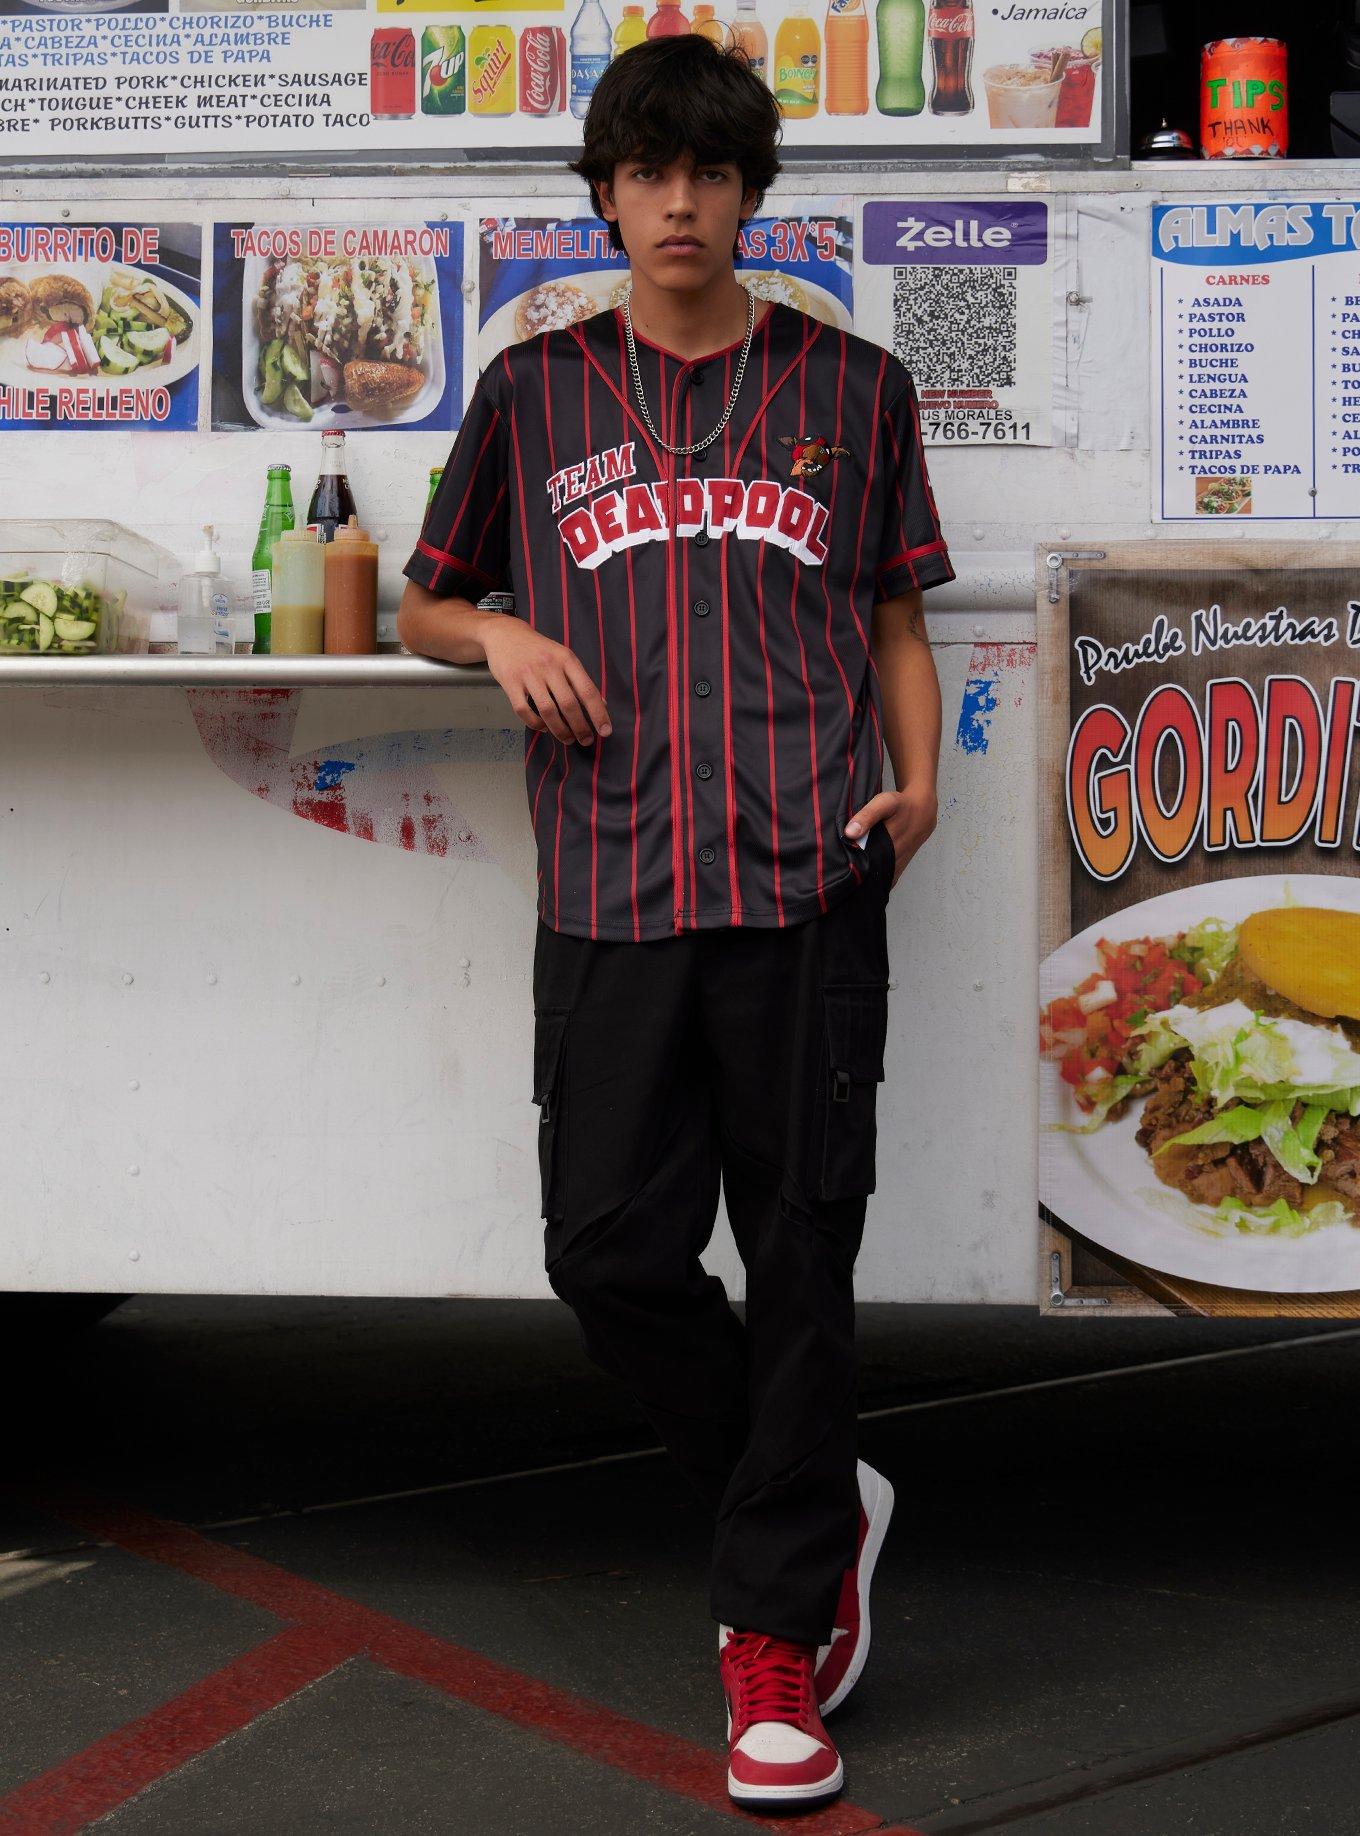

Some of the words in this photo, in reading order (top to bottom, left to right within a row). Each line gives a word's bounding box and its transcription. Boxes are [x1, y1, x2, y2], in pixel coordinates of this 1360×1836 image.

[1000, 2, 1088, 21] Jamaica
[10, 18, 83, 33] PASTOR
[94, 16, 157, 31] POLLO
[169, 15, 255, 30] CHORIZO
[265, 13, 333, 29] BUCHE
[24, 35, 99, 50] CABEZA
[110, 33, 182, 49] CECINA
[192, 31, 291, 47] ALAMBRE
[41, 51, 109, 67] TRIPAS
[120, 50, 180, 65] TACOS
[187, 50, 214, 64] DE
[220, 49, 272, 64] PAPA
[115, 75, 169, 90] PORK
[180, 73, 267, 89] CHICKEN
[277, 72, 368, 87] SAUSAGE
[38, 96, 113, 112] TONGUE
[125, 95, 188, 110] CHEEK
[197, 94, 249, 109] MEAT
[259, 93, 332, 108] CECINA
[1206, 78, 1285, 112] TIPS
[174, 114, 233, 130] GUTTS
[244, 113, 315, 129] POTATO
[322, 112, 371, 127] TACO
[1207, 117, 1274, 138] THANK
[896, 217, 1012, 251] Zelle
[1158, 204, 1315, 252] ALMAS
[0, 227, 115, 264] BURRITO
[122, 227, 159, 264] DE
[231, 228, 302, 259] TACOS
[307, 228, 336, 258] DE
[343, 228, 449, 258] CAMARON
[1205, 274, 1270, 285] CARNES
[1192, 297, 1243, 308] ASADA
[1188, 312, 1246, 323] PASTOR
[1188, 327, 1235, 338] POLLO
[1188, 342, 1255, 353] CHORIZO
[1188, 358, 1239, 368] BUCHE
[1188, 373, 1249, 384] LENGUA
[947, 389, 993, 399] NUMBER
[1188, 388, 1248, 399] CABEZA
[57, 386, 171, 421] RELLENO
[1188, 403, 1245, 414] CECINA
[944, 410, 1013, 421] MORALES
[1189, 418, 1261, 429] ALAMBRE
[1189, 434, 1265, 444] CARNITAS
[1189, 449, 1242, 460] TRIPAS
[546, 442, 637, 514] TEAM
[1189, 464, 1236, 475] TACOS
[1240, 464, 1260, 475] DE
[1263, 464, 1302, 475] PAPA
[558, 478, 830, 570] DEADPOOL
[1076, 615, 1186, 685] Pruebe
[1192, 604, 1338, 655] Nuestras
[1066, 675, 1360, 882] GORDI
